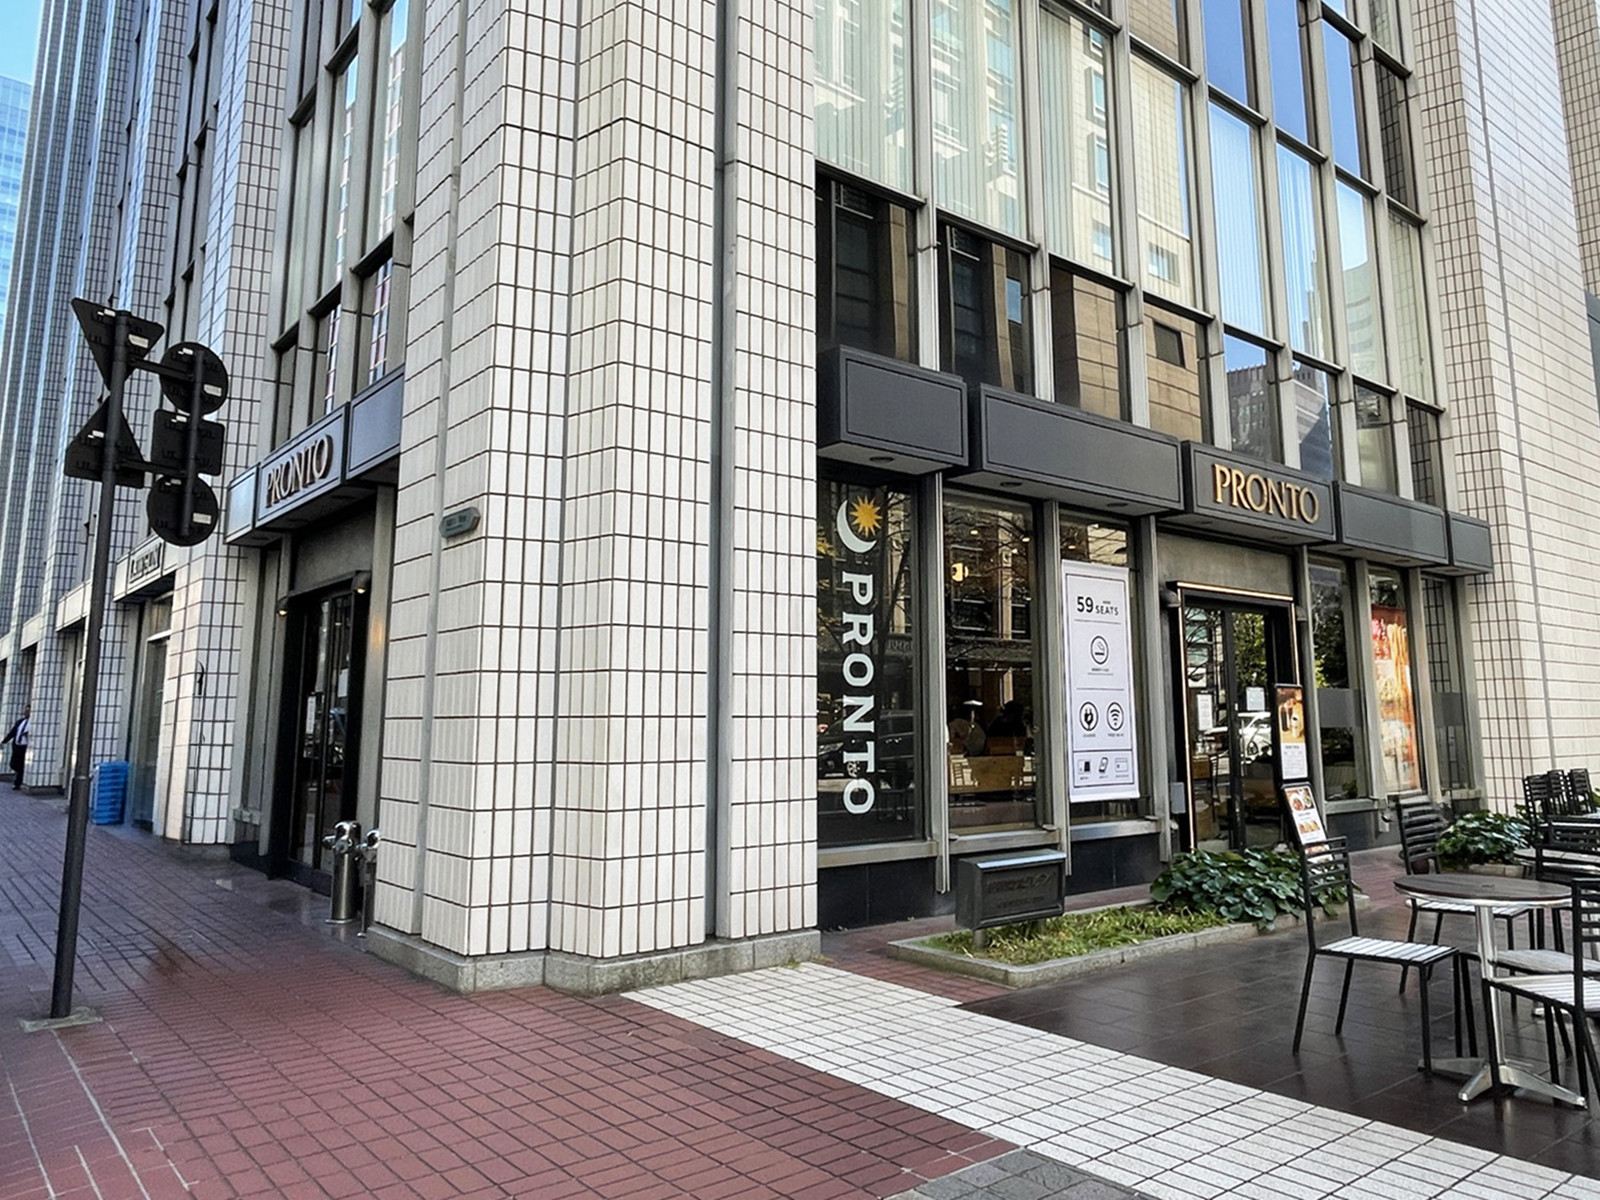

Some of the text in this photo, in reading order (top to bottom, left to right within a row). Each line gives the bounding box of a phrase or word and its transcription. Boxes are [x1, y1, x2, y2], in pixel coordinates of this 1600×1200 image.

[266, 434, 333, 508] PRONTO
[1213, 463, 1319, 524] PRONTO
[1077, 596, 1119, 616] 59 SEATS
[842, 571, 875, 814] PRONTO
